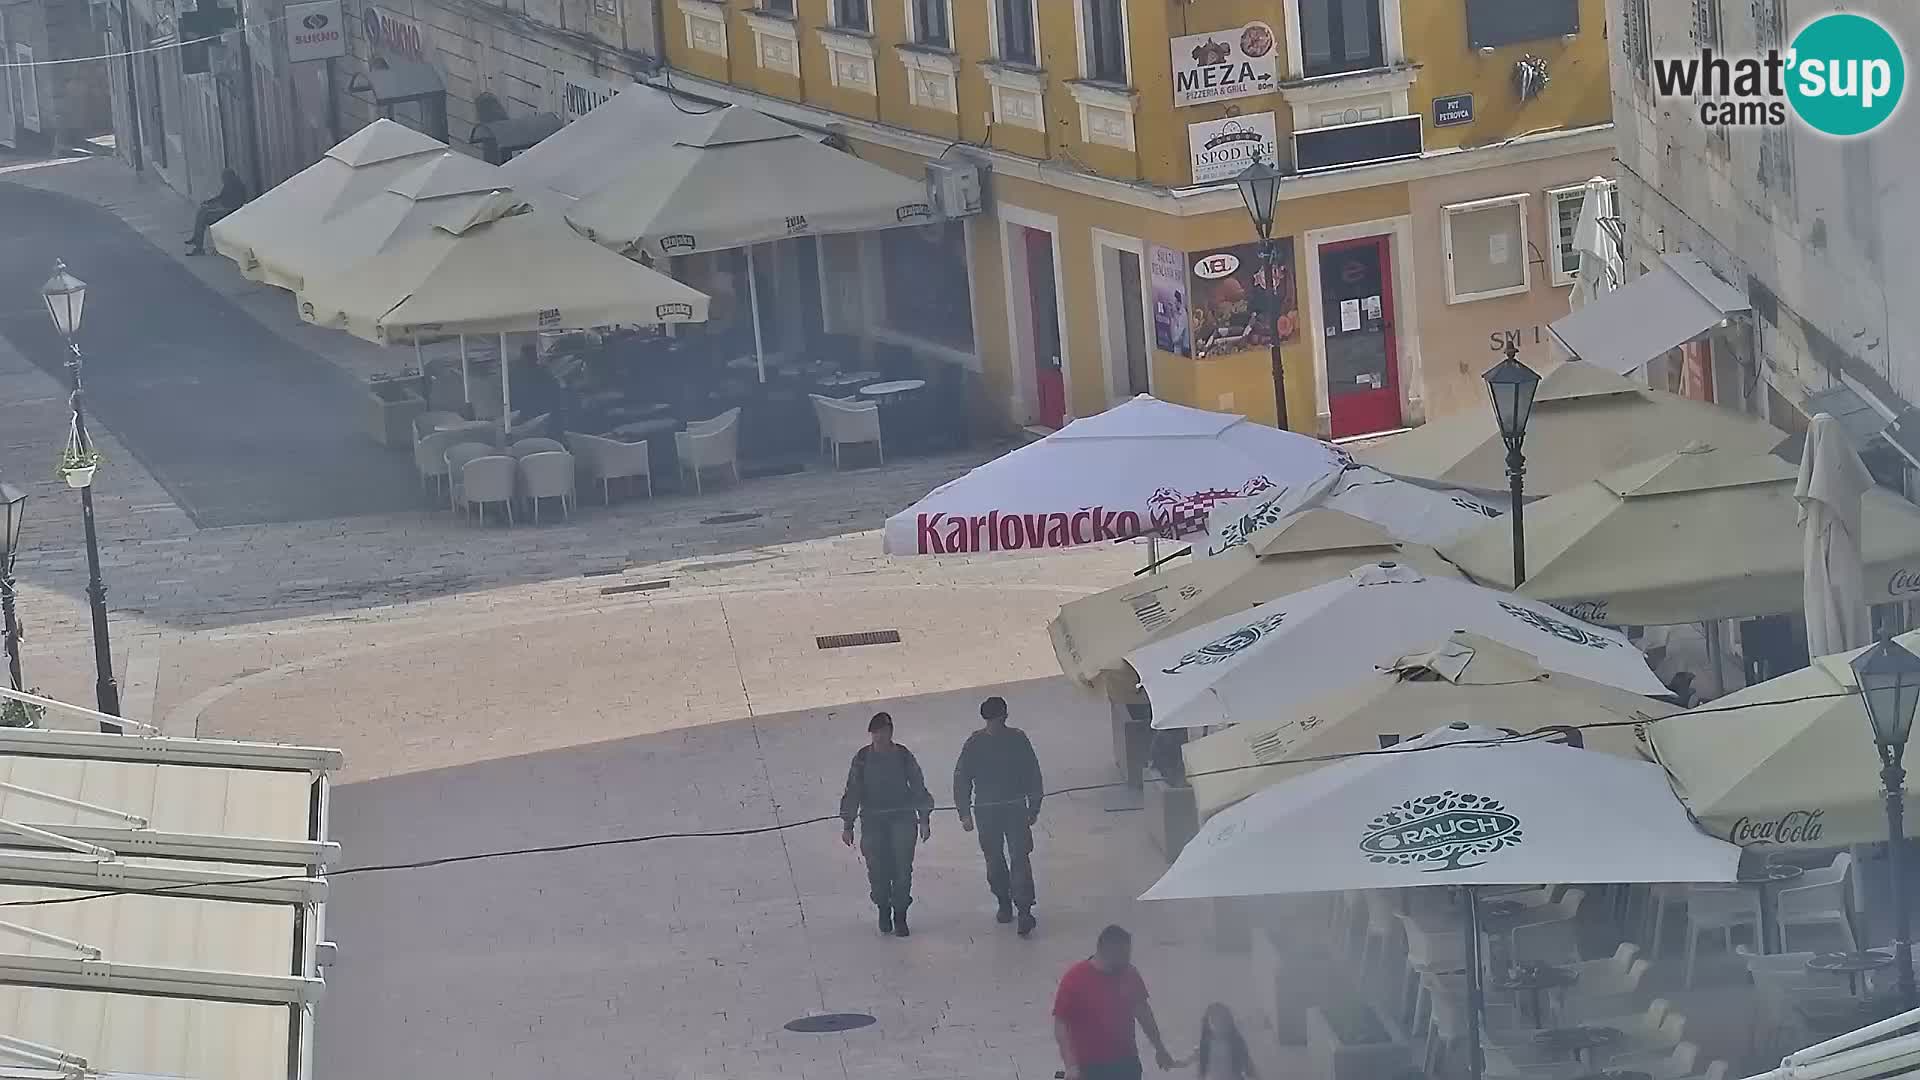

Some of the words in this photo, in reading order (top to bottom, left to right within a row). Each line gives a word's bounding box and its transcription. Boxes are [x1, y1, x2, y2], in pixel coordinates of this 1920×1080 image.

[295, 31, 339, 45] SUKNO
[1177, 61, 1256, 92] MEZA
[1186, 87, 1219, 100] PIZZERIA
[1226, 83, 1248, 95] GRILL
[1439, 110, 1469, 121] PETROVCA
[1447, 101, 1459, 110] PUT
[1195, 147, 1241, 166] ISPOD
[1245, 141, 1275, 158] URE
[917, 506, 1141, 554] Karlovačko
[1401, 817, 1500, 845] RAUCH
[1730, 809, 1824, 847] Coca-Cola
